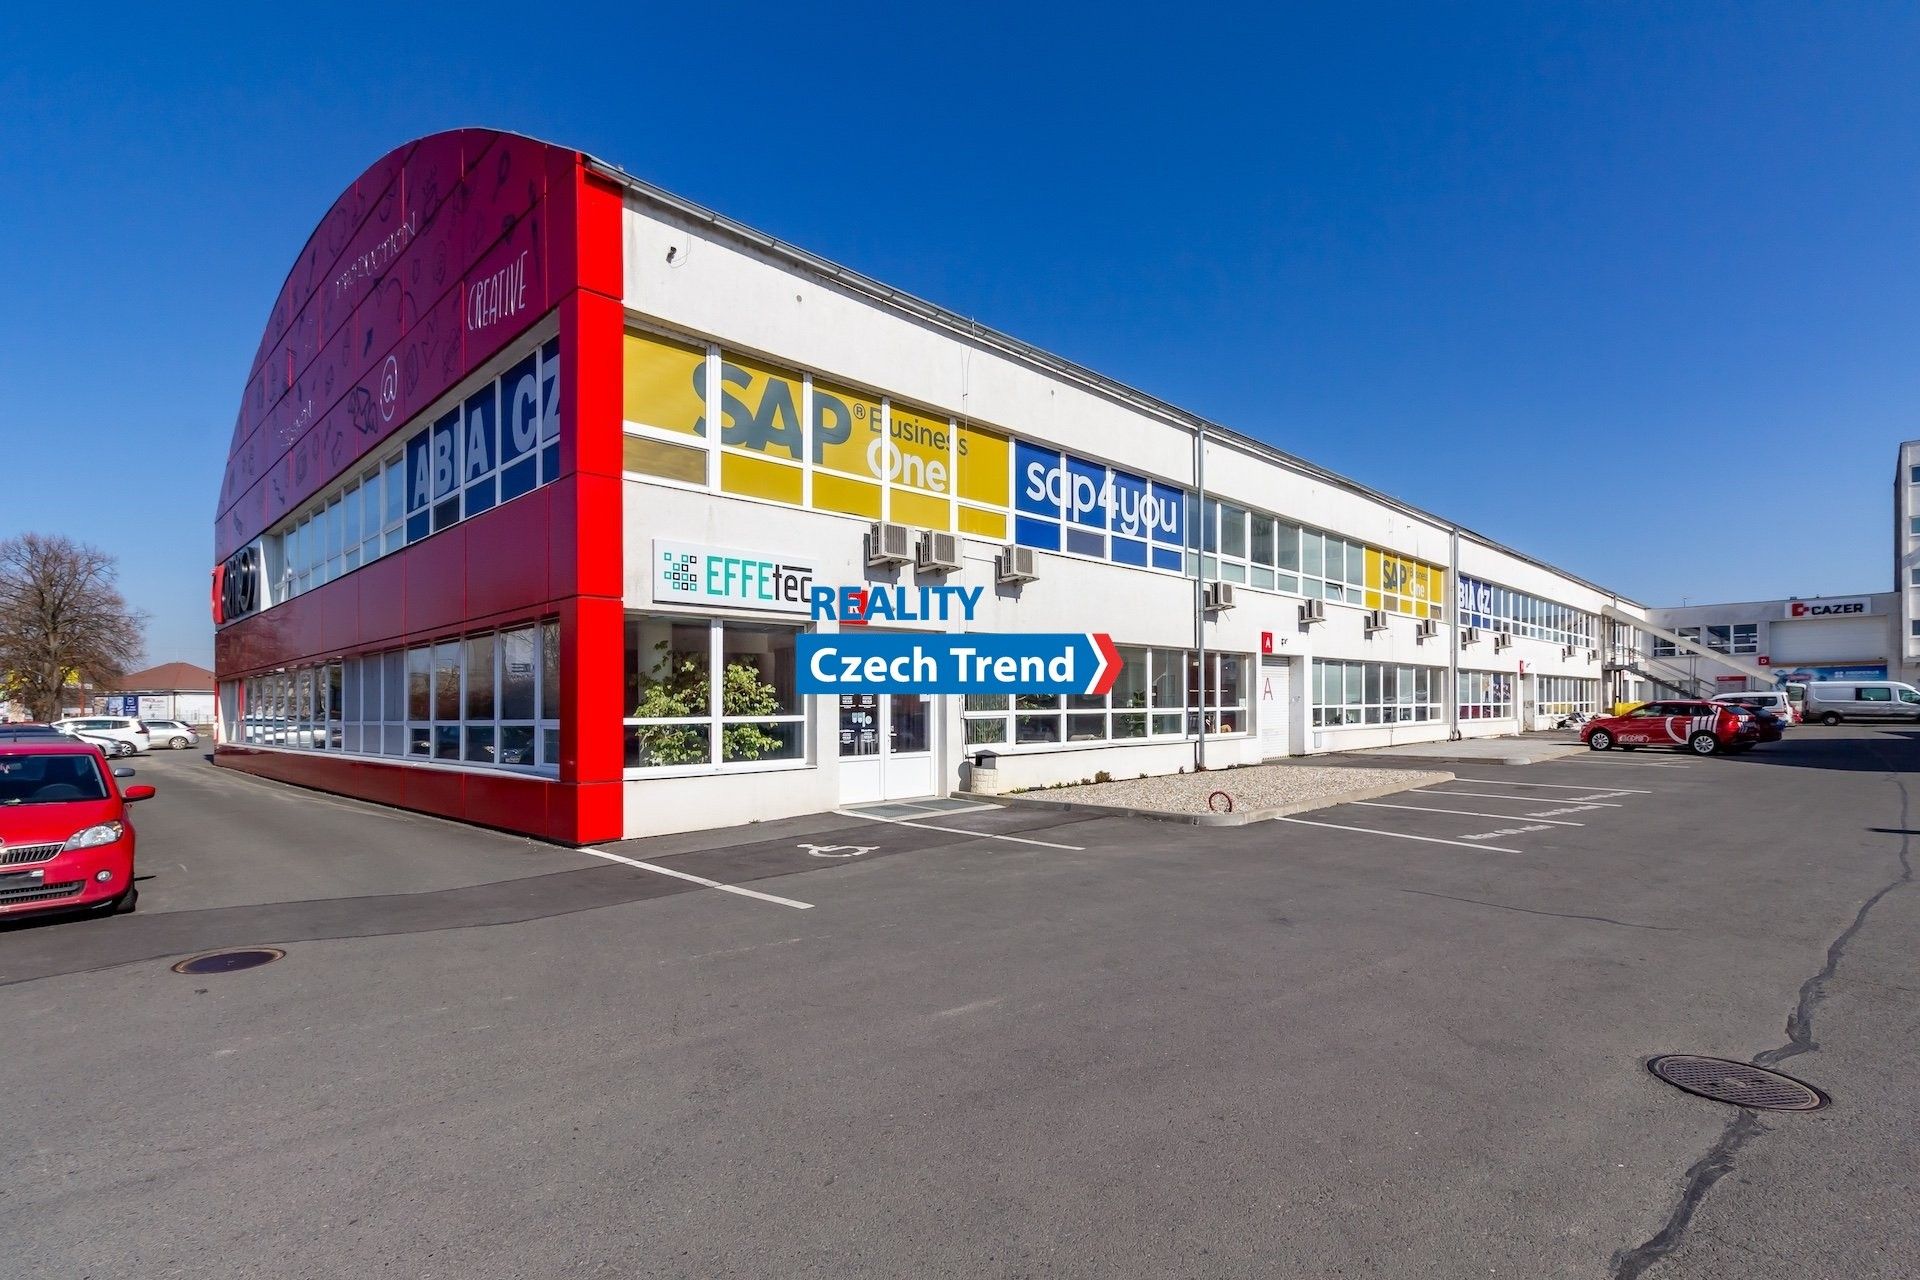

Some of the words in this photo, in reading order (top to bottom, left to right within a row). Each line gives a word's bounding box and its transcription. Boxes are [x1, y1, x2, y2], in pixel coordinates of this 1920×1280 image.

[468, 250, 528, 330] CREATIVE
[413, 407, 488, 509] ABIA
[512, 354, 560, 452] CZ
[867, 437, 947, 492] One
[1026, 462, 1176, 536] sap4you
[707, 556, 812, 603] EFFEtec
[1383, 560, 1406, 592] SAP
[1409, 580, 1424, 598] One
[1812, 604, 1864, 616] CAZER
[1265, 636, 1271, 648] A
[1263, 677, 1273, 700] A
